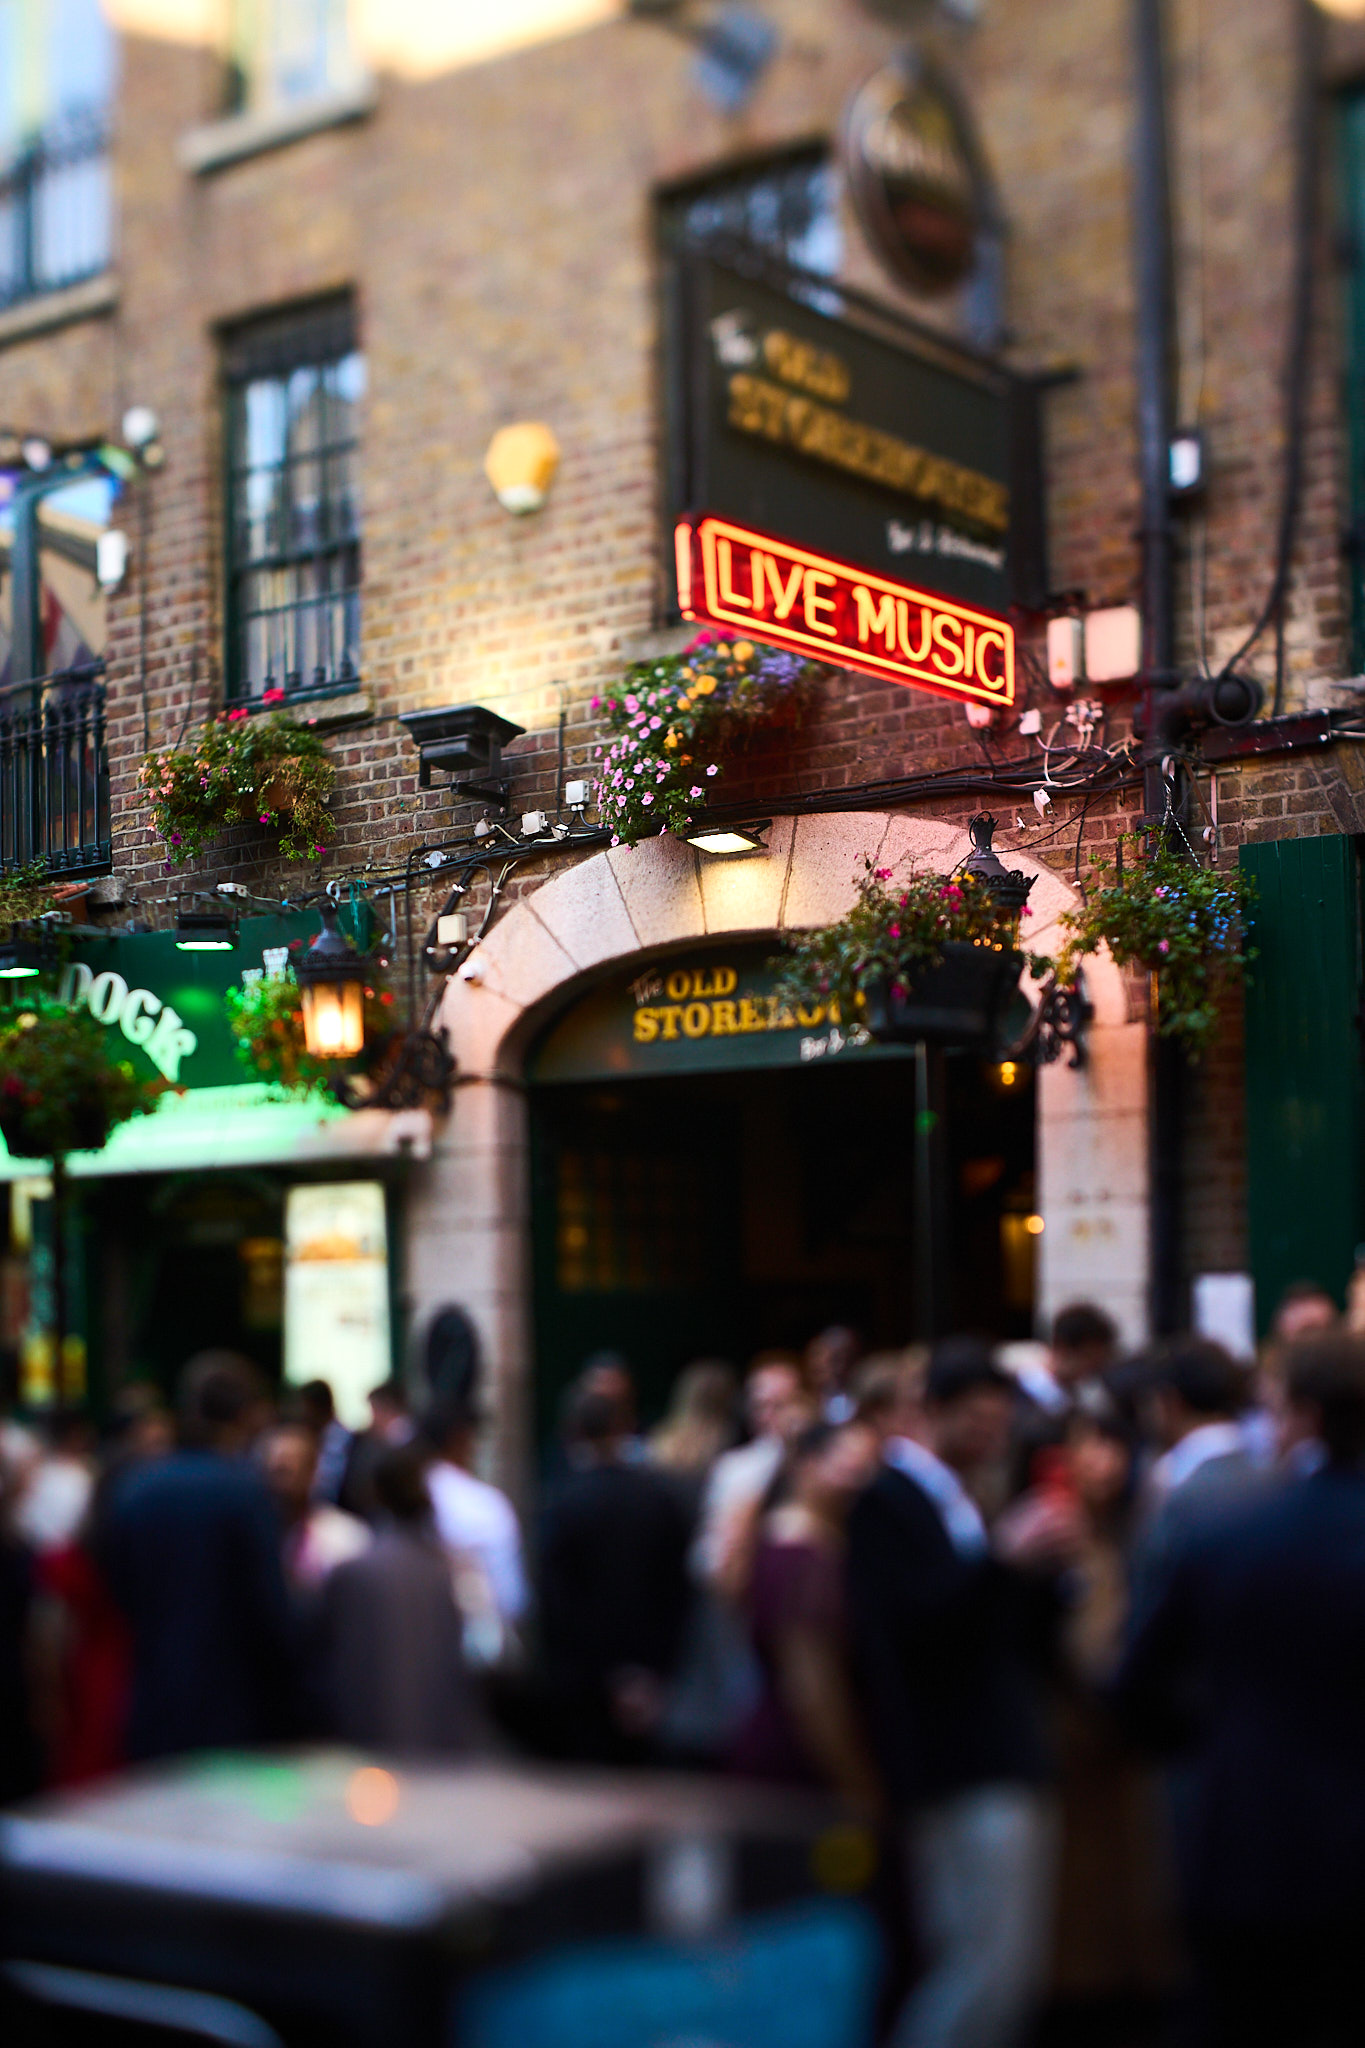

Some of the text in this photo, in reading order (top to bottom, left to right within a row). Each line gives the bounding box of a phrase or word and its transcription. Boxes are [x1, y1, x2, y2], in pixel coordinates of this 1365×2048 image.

[716, 537, 838, 637] LIVE
[851, 584, 1006, 691] MUSIC
[665, 966, 738, 1001] OLD
